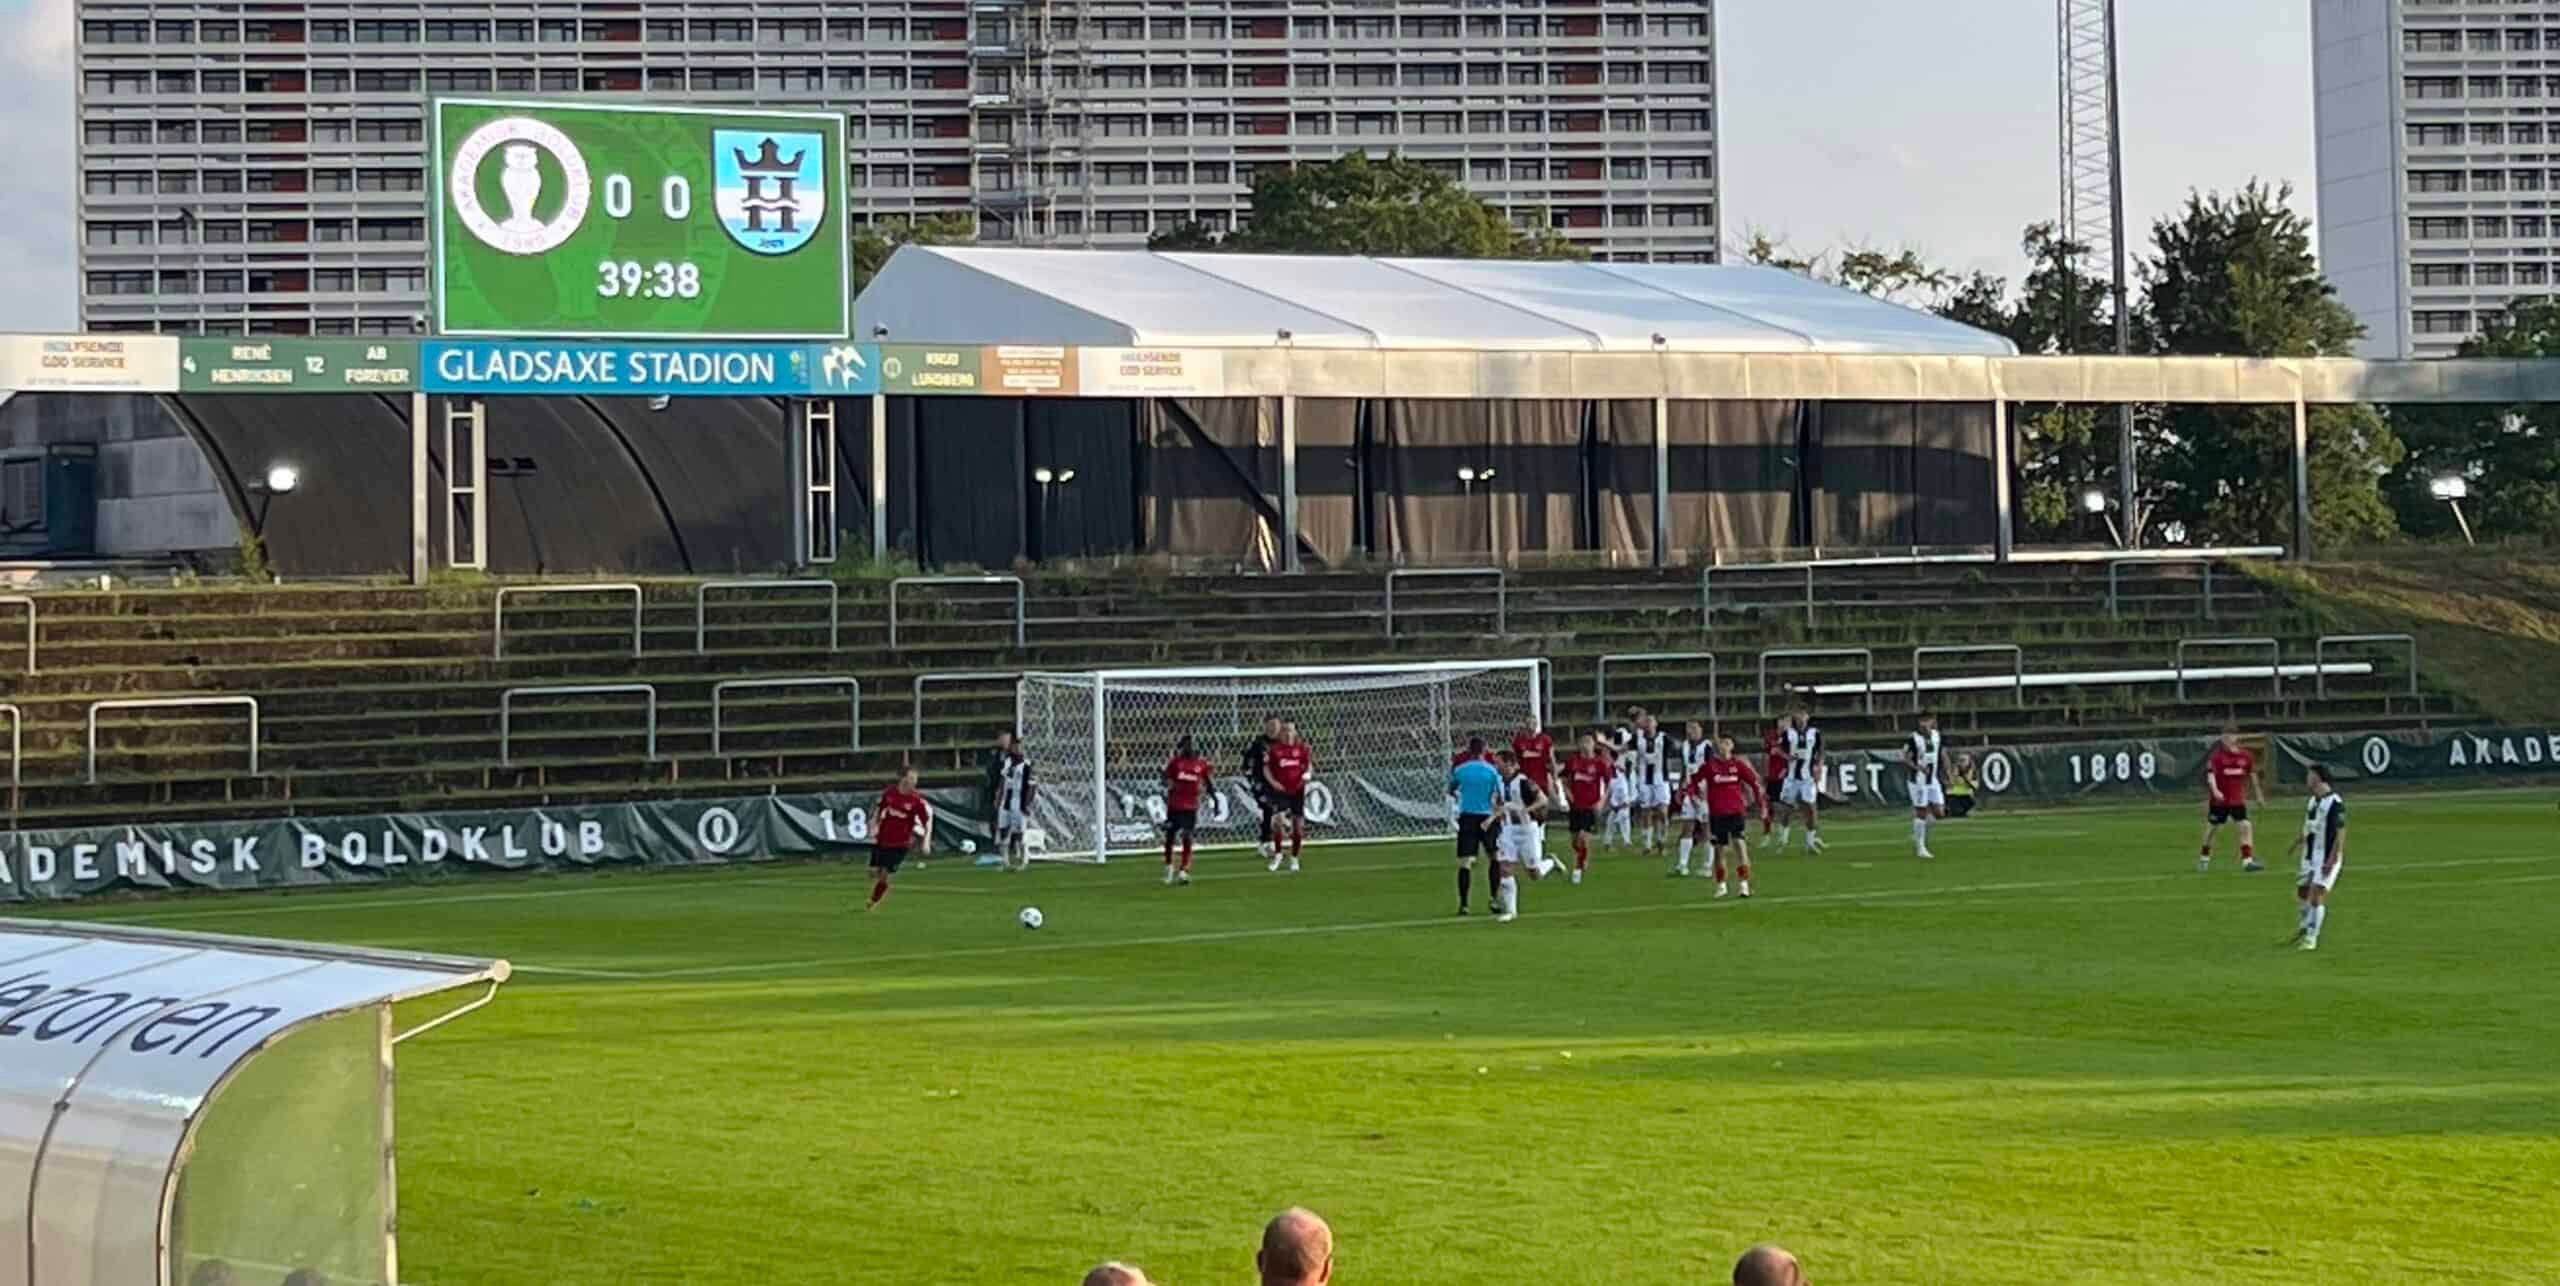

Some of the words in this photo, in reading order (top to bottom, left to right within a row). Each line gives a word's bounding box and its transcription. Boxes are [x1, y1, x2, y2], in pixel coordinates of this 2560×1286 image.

[605, 173, 632, 218] 0
[664, 175, 690, 219] 0
[597, 261, 700, 298] 39:38
[182, 355, 197, 374] 4
[304, 356, 325, 374] 12
[366, 346, 387, 361] AB
[211, 368, 293, 384] HENRIKSEN
[344, 368, 410, 384] FOREVER
[438, 349, 618, 383] GLADSAXE
[628, 351, 775, 385] STADION
[2069, 752, 2155, 783] 1889
[301, 820, 604, 869] BOLDKLUB
